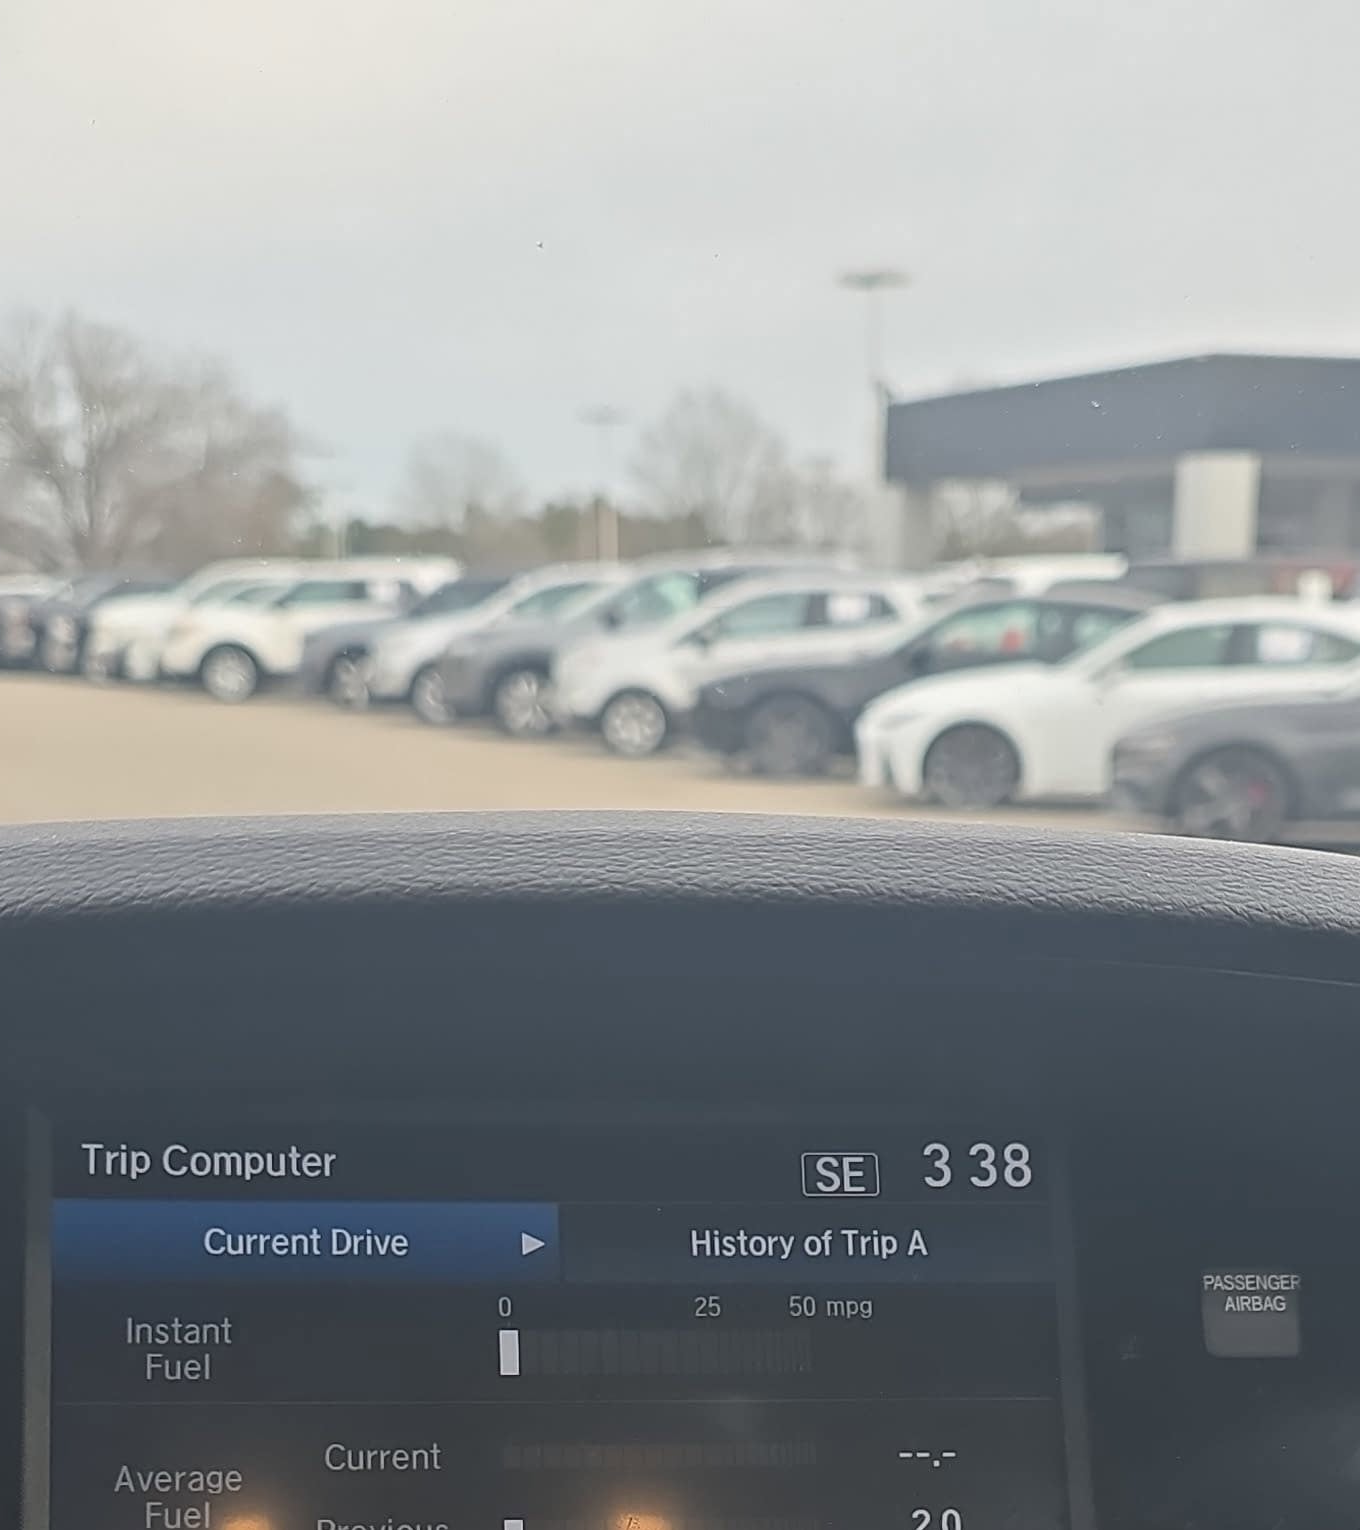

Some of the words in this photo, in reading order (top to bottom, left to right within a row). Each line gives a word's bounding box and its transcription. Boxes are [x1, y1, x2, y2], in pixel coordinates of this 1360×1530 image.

[81, 1143, 151, 1180] Trip
[162, 1144, 337, 1181] Computer
[815, 1156, 866, 1192] SE
[204, 1227, 321, 1255] Current
[331, 1228, 409, 1256] Drive
[691, 1229, 795, 1260] History
[803, 1229, 833, 1256] of
[840, 1229, 898, 1260] Trip
[907, 1229, 928, 1256] A
[1202, 1274, 1301, 1291] PASSENGER
[498, 1296, 512, 1317] 0
[694, 1295, 721, 1317] 25
[789, 1295, 816, 1317] 50
[826, 1300, 873, 1319] mpg
[1225, 1295, 1287, 1312] AIRBAG
[127, 1317, 232, 1345] Instant
[146, 1353, 210, 1380] Fuel
[324, 1442, 441, 1471] Current
[114, 1465, 243, 1494] Average
[144, 1501, 211, 1530] Fuel
